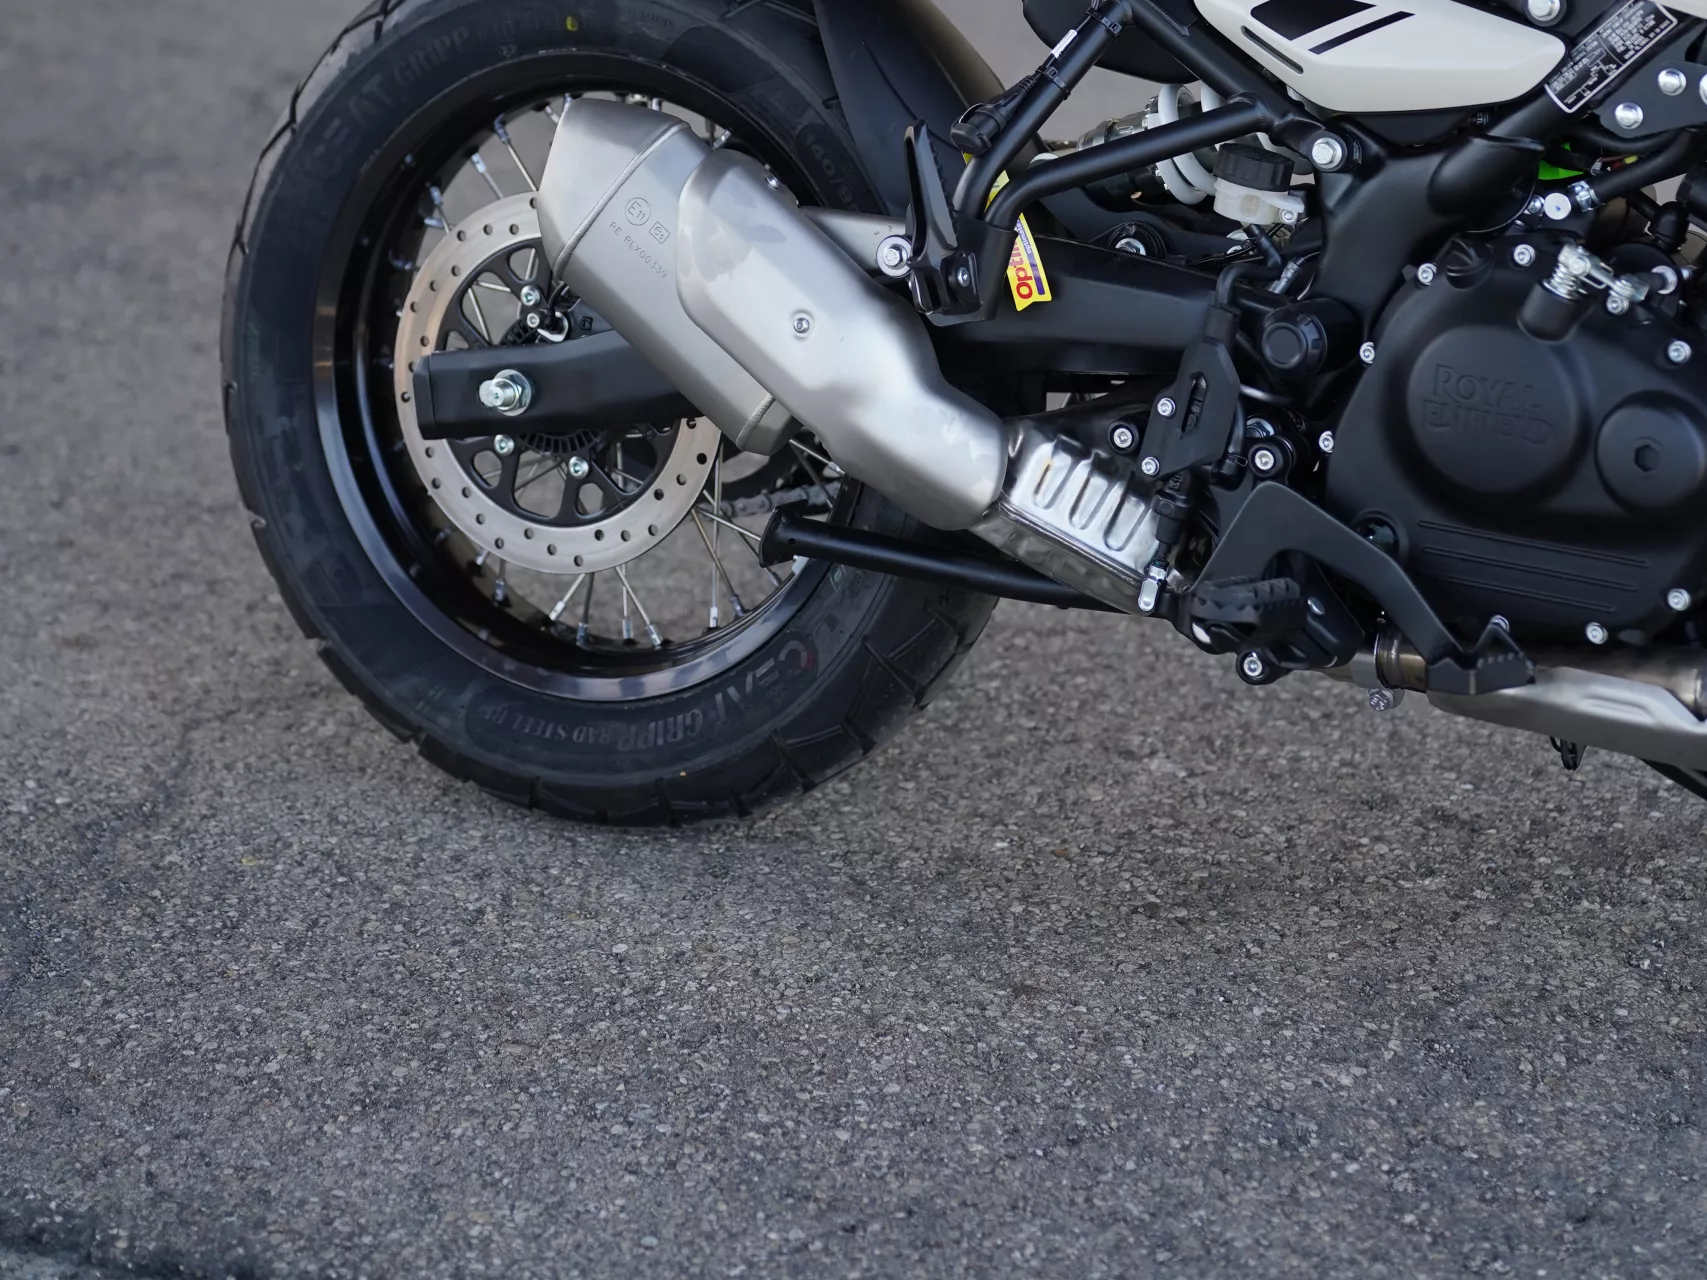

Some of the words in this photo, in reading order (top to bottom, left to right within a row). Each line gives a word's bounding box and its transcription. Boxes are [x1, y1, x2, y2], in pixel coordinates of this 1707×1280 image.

[1433, 364, 1543, 412] ROYAL
[511, 712, 569, 741] STEEL
[616, 709, 703, 752] GRIPP
